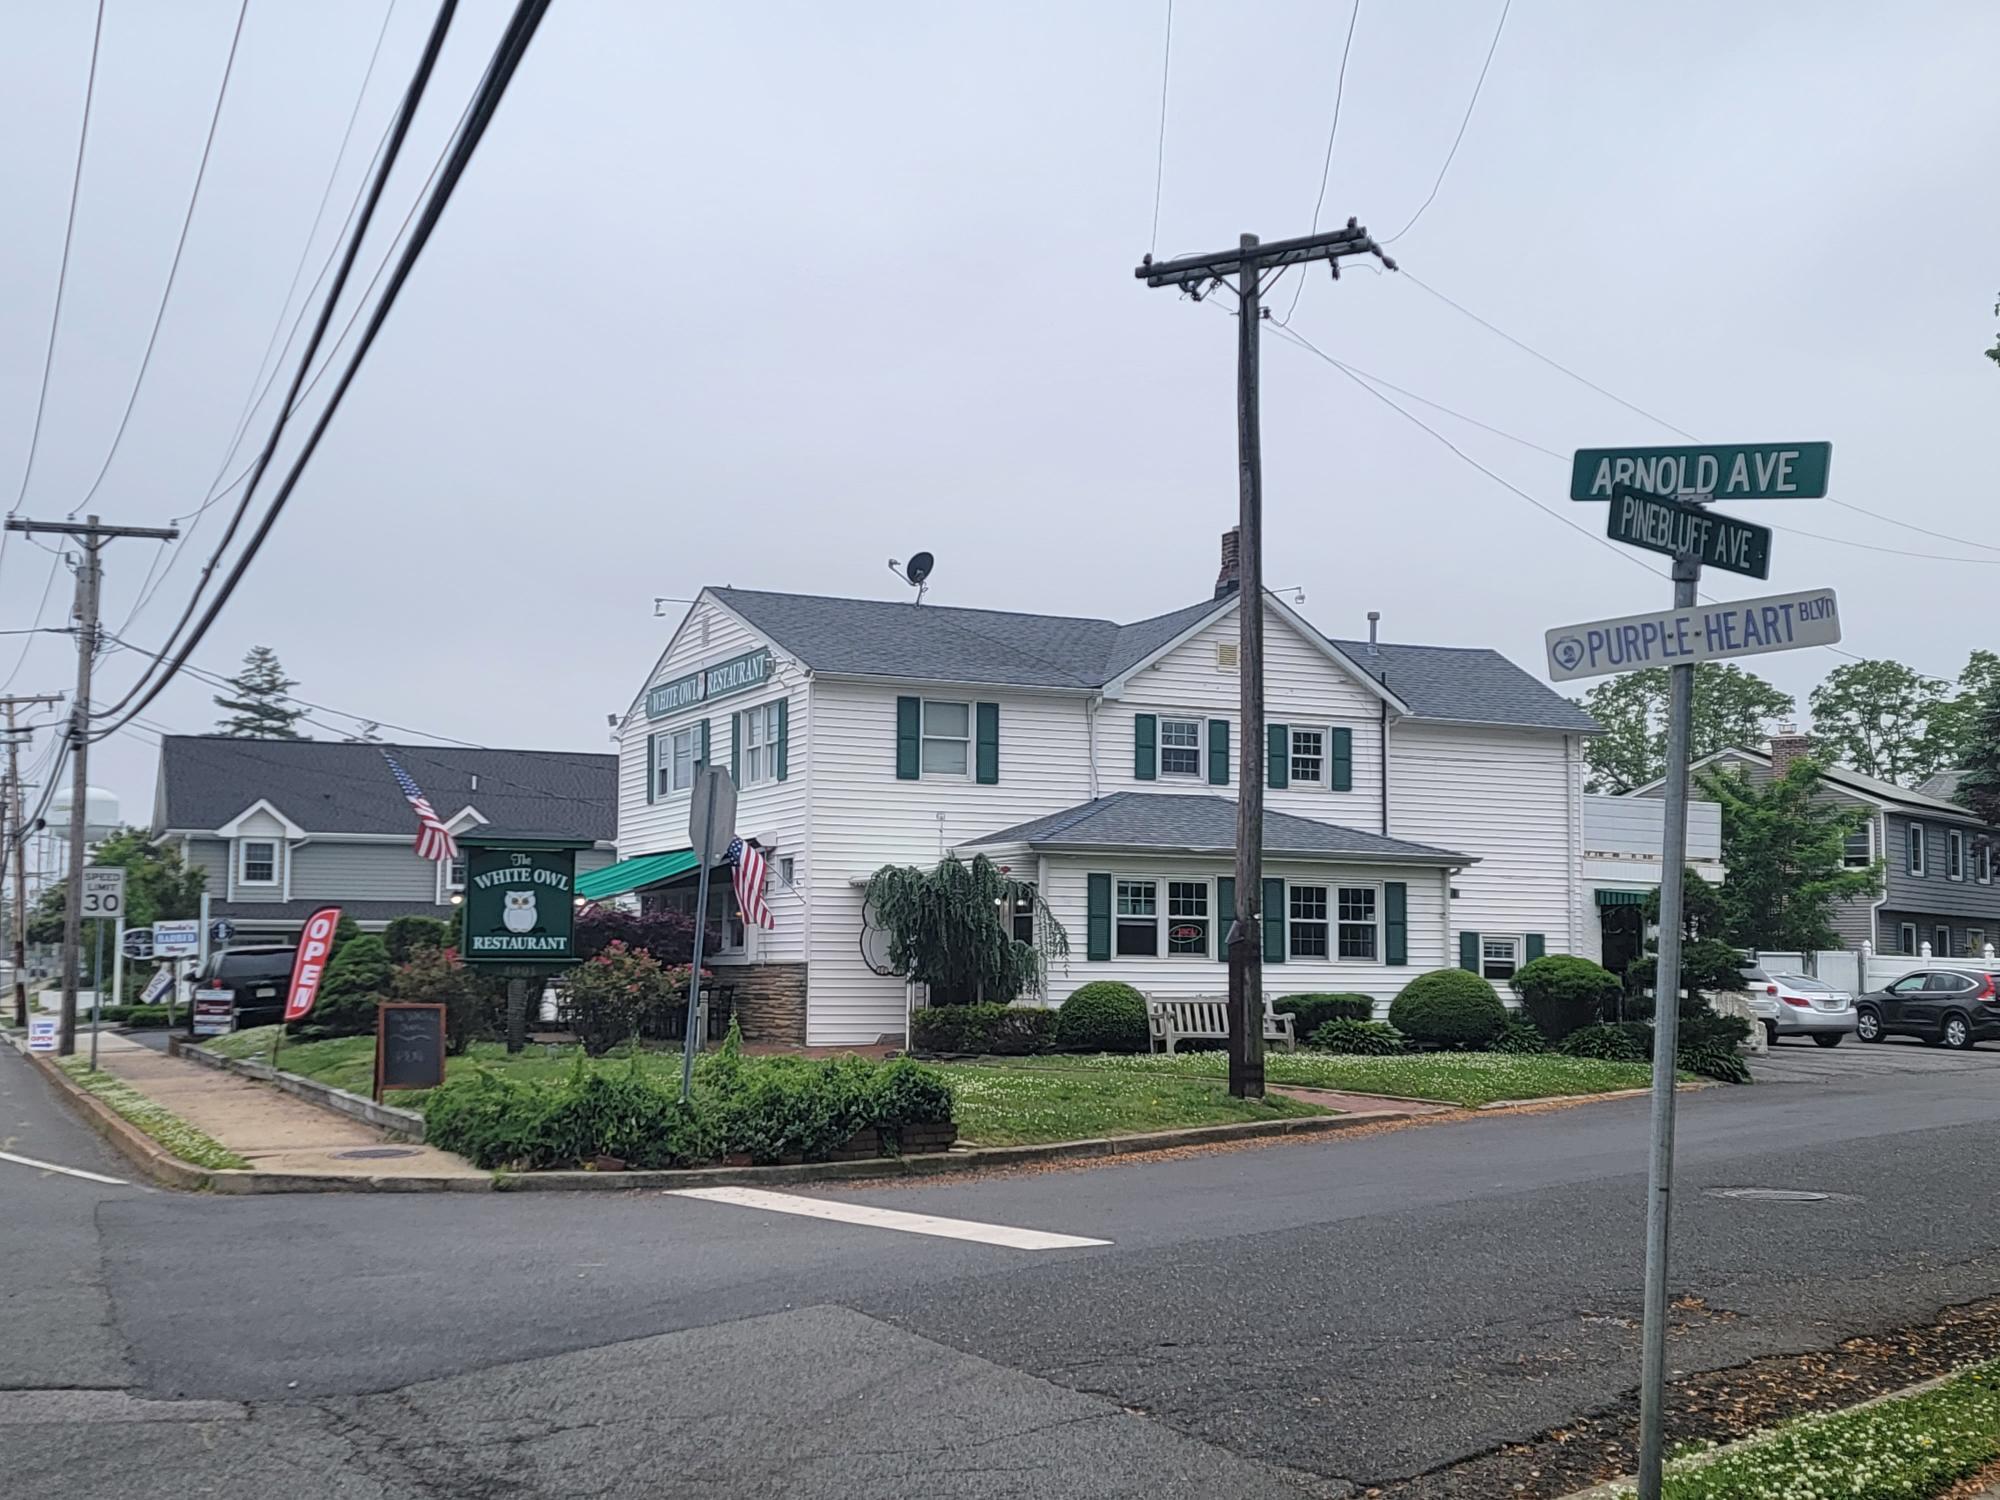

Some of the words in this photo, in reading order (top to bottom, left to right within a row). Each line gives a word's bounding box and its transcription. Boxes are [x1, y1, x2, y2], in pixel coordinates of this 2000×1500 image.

[1591, 454, 1719, 495] ARNOLD
[1727, 451, 1799, 492] AVE
[1620, 496, 1712, 554] PINEBLUFF
[1714, 523, 1753, 568] AVE
[1586, 617, 1694, 668] PURPLE
[1703, 603, 1795, 652] HEART
[1798, 595, 1836, 622] BLVD
[652, 684, 679, 713] WHITE
[679, 679, 699, 707] OWL
[706, 653, 766, 694] RESTAURANT
[510, 853, 532, 866] The
[83, 872, 121, 881] SPEED
[87, 883, 118, 891] LIMIT
[473, 867, 532, 889] WHITE
[533, 868, 569, 891] OWL
[83, 894, 119, 911] 30
[472, 936, 568, 950] RESTAURANT
[292, 918, 330, 1008] OPEN
